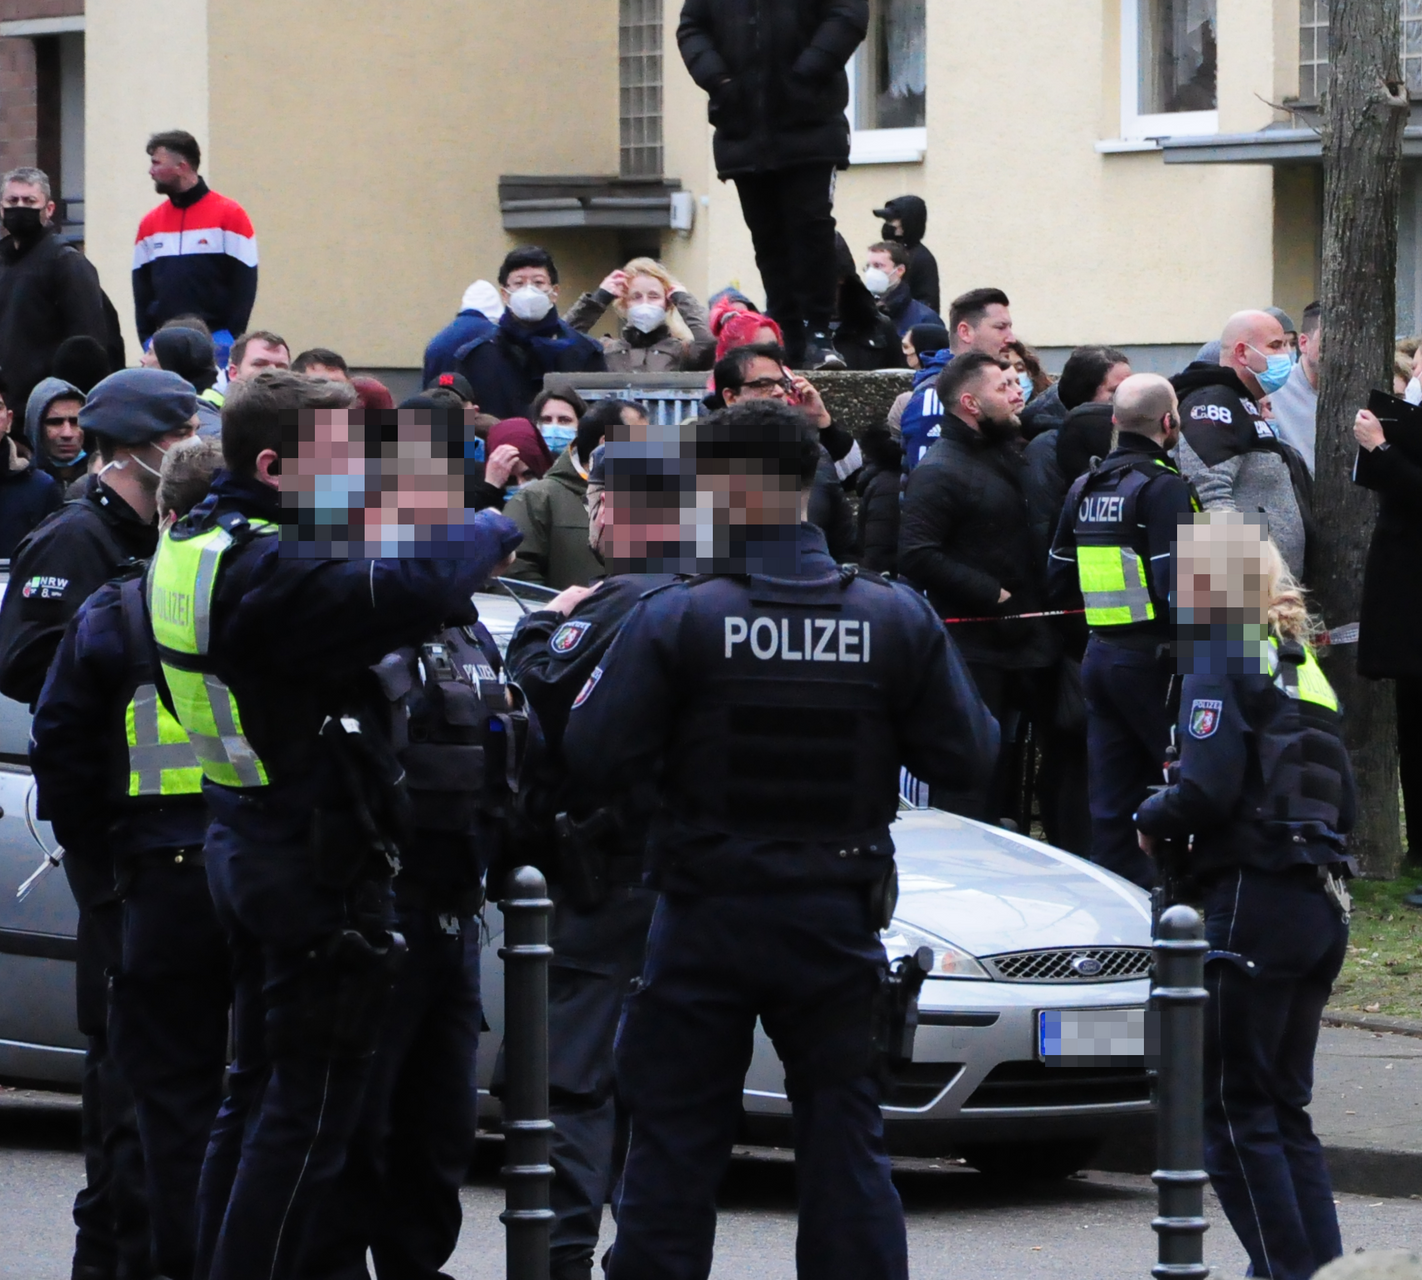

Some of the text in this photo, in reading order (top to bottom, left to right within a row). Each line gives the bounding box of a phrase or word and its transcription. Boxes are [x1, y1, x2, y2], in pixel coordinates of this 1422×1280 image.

[1078, 496, 1125, 522] OLIZEI
[41, 576, 69, 588] NRW
[724, 616, 871, 663] POLIZEI
